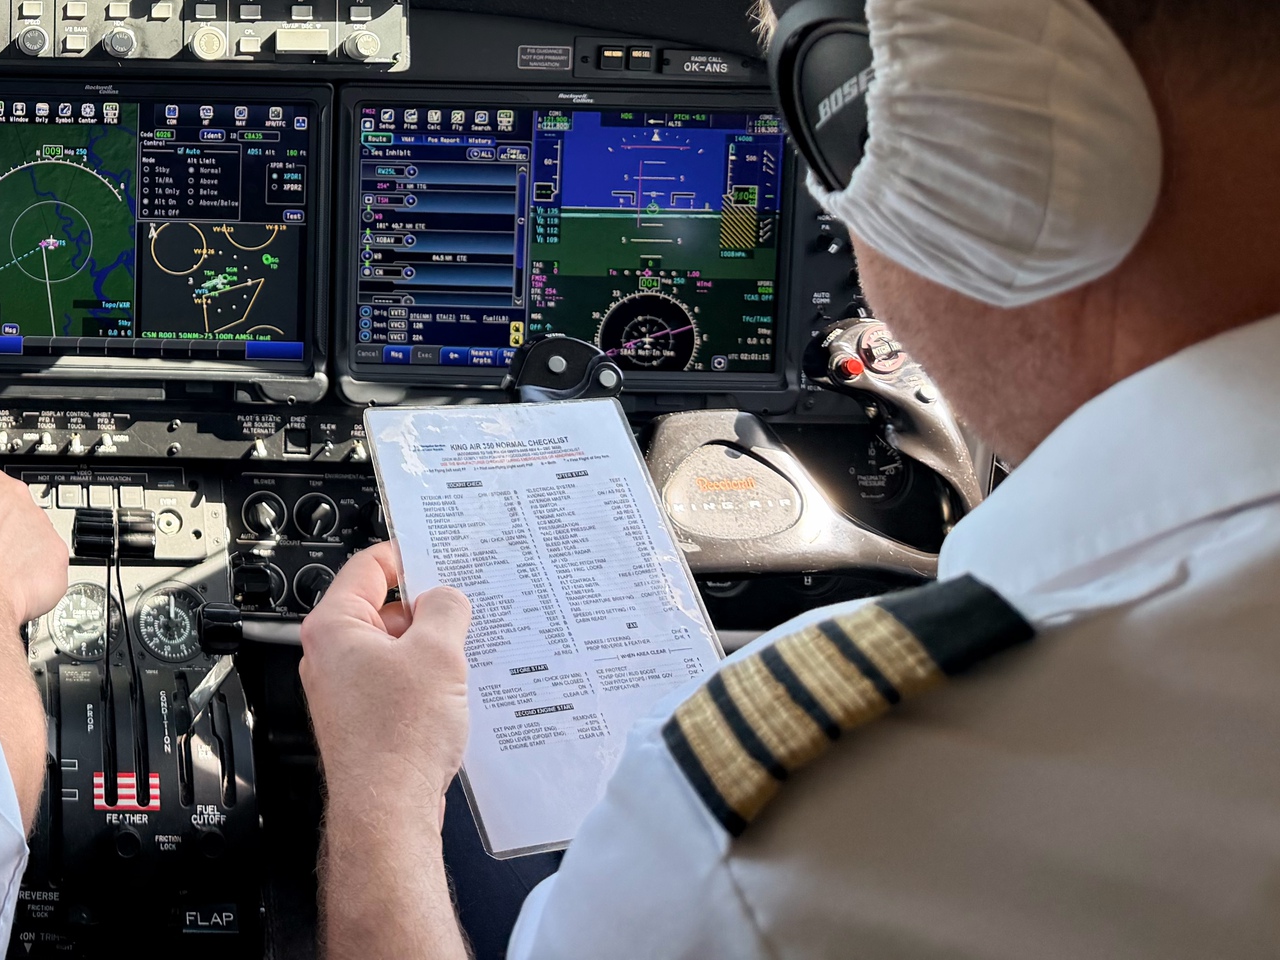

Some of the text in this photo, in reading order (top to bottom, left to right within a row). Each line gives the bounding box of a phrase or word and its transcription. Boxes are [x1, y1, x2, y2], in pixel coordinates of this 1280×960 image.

[683, 62, 728, 74] OK-ANS
[44, 147, 61, 156] 009
[740, 352, 770, 360] 02:01:15
[496, 440, 527, 449] NORMAL
[528, 436, 569, 447] CHECKLIST
[696, 476, 757, 492] Beechcraft
[673, 501, 735, 512] KING
[159, 690, 171, 754] CONDITION
[196, 804, 220, 815] FUEL
[191, 814, 226, 825] CUTOFF
[155, 835, 182, 843] FRICTION
[160, 843, 176, 851] LOCK
[19, 890, 60, 901] REVERSE
[186, 912, 234, 926] FLAP
